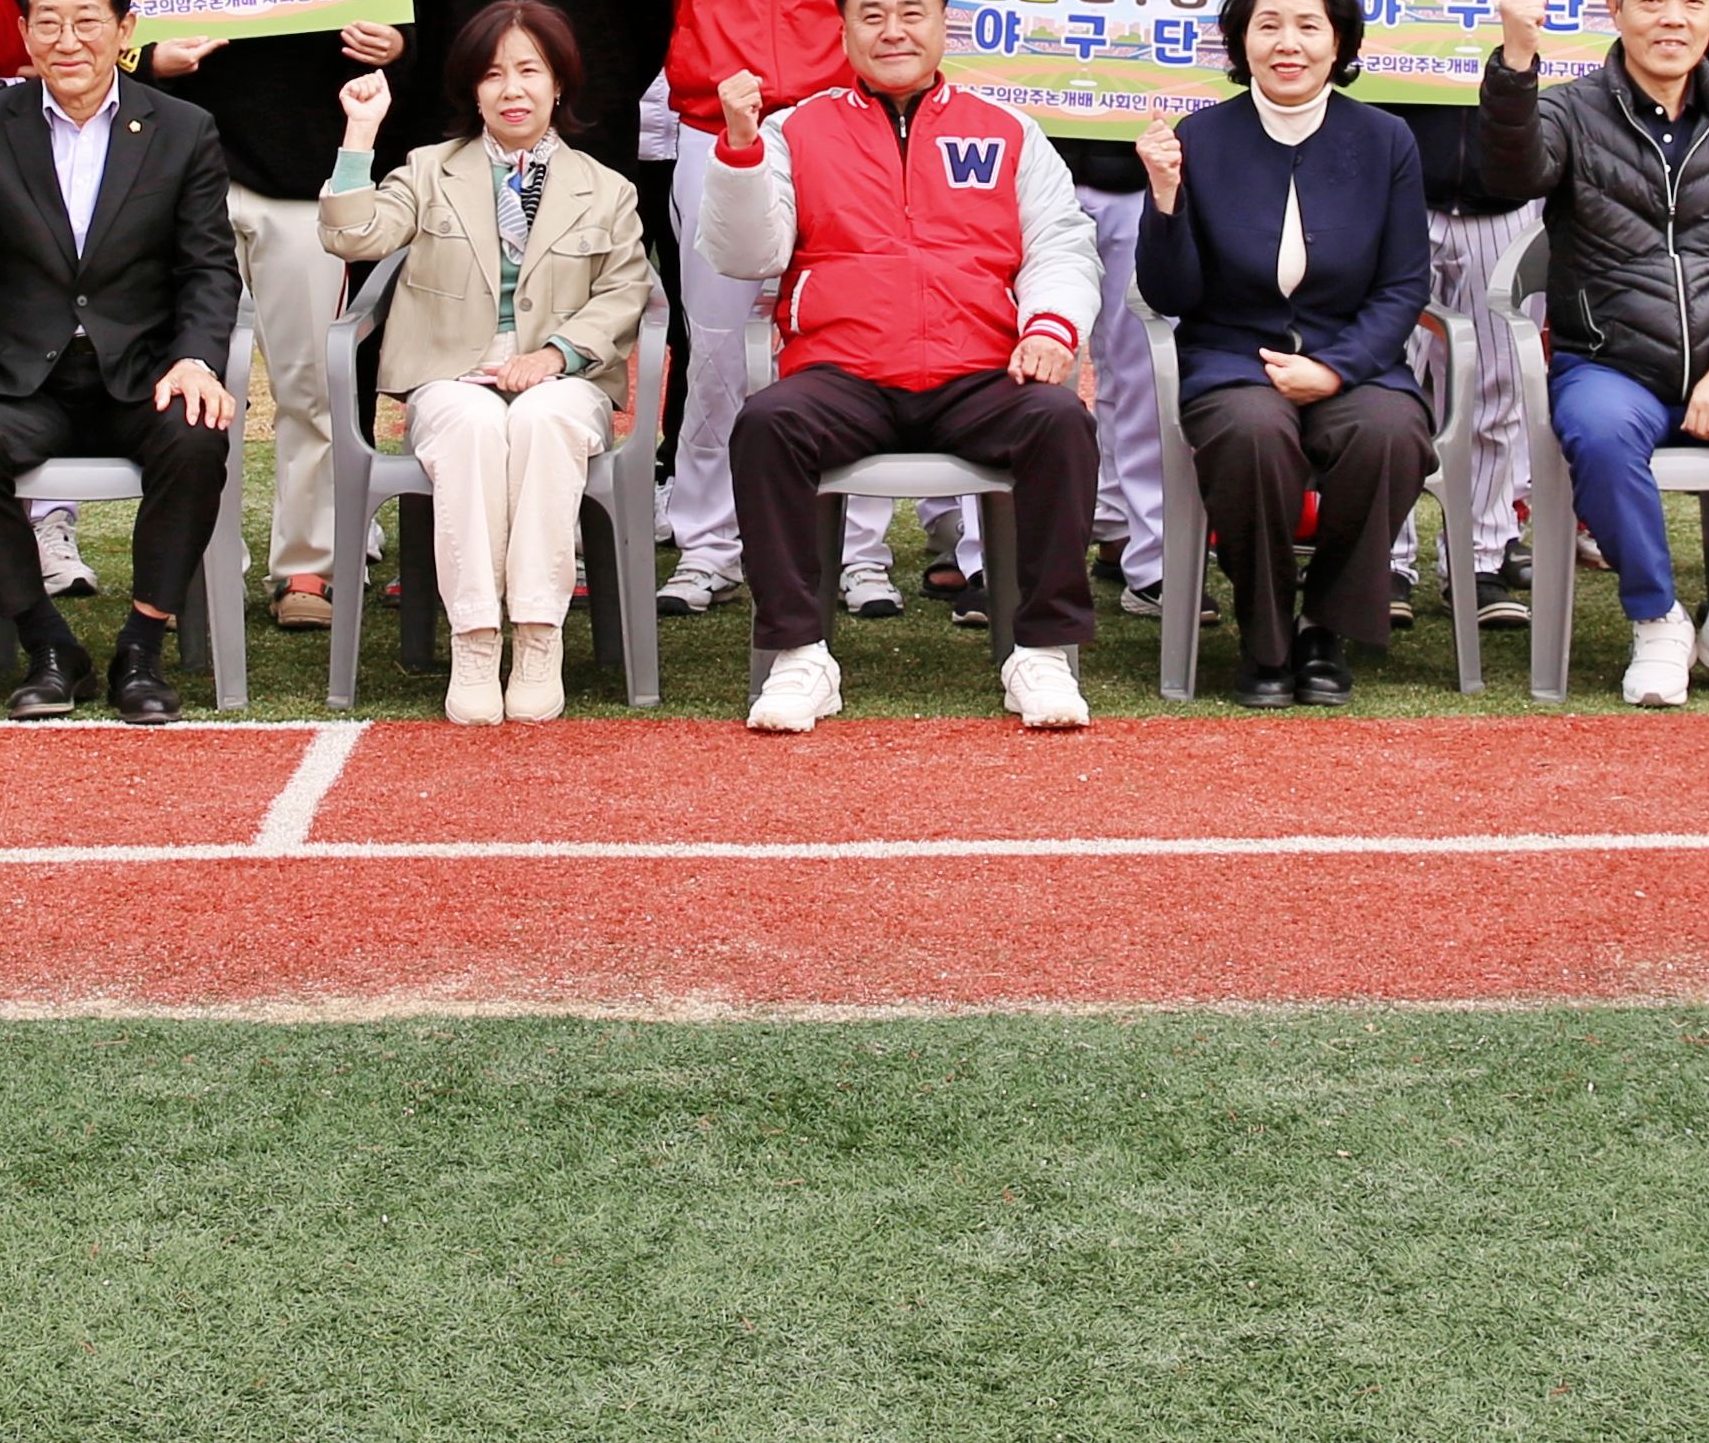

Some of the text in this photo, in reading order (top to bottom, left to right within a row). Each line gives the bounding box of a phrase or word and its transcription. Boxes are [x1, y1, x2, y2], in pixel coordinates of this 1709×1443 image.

[1351, 55, 1479, 74] 수군의암주논개배
[950, 84, 1093, 109] 군의암주논개배
[1098, 92, 1147, 111] 사회인
[935, 135, 1005, 190] W
